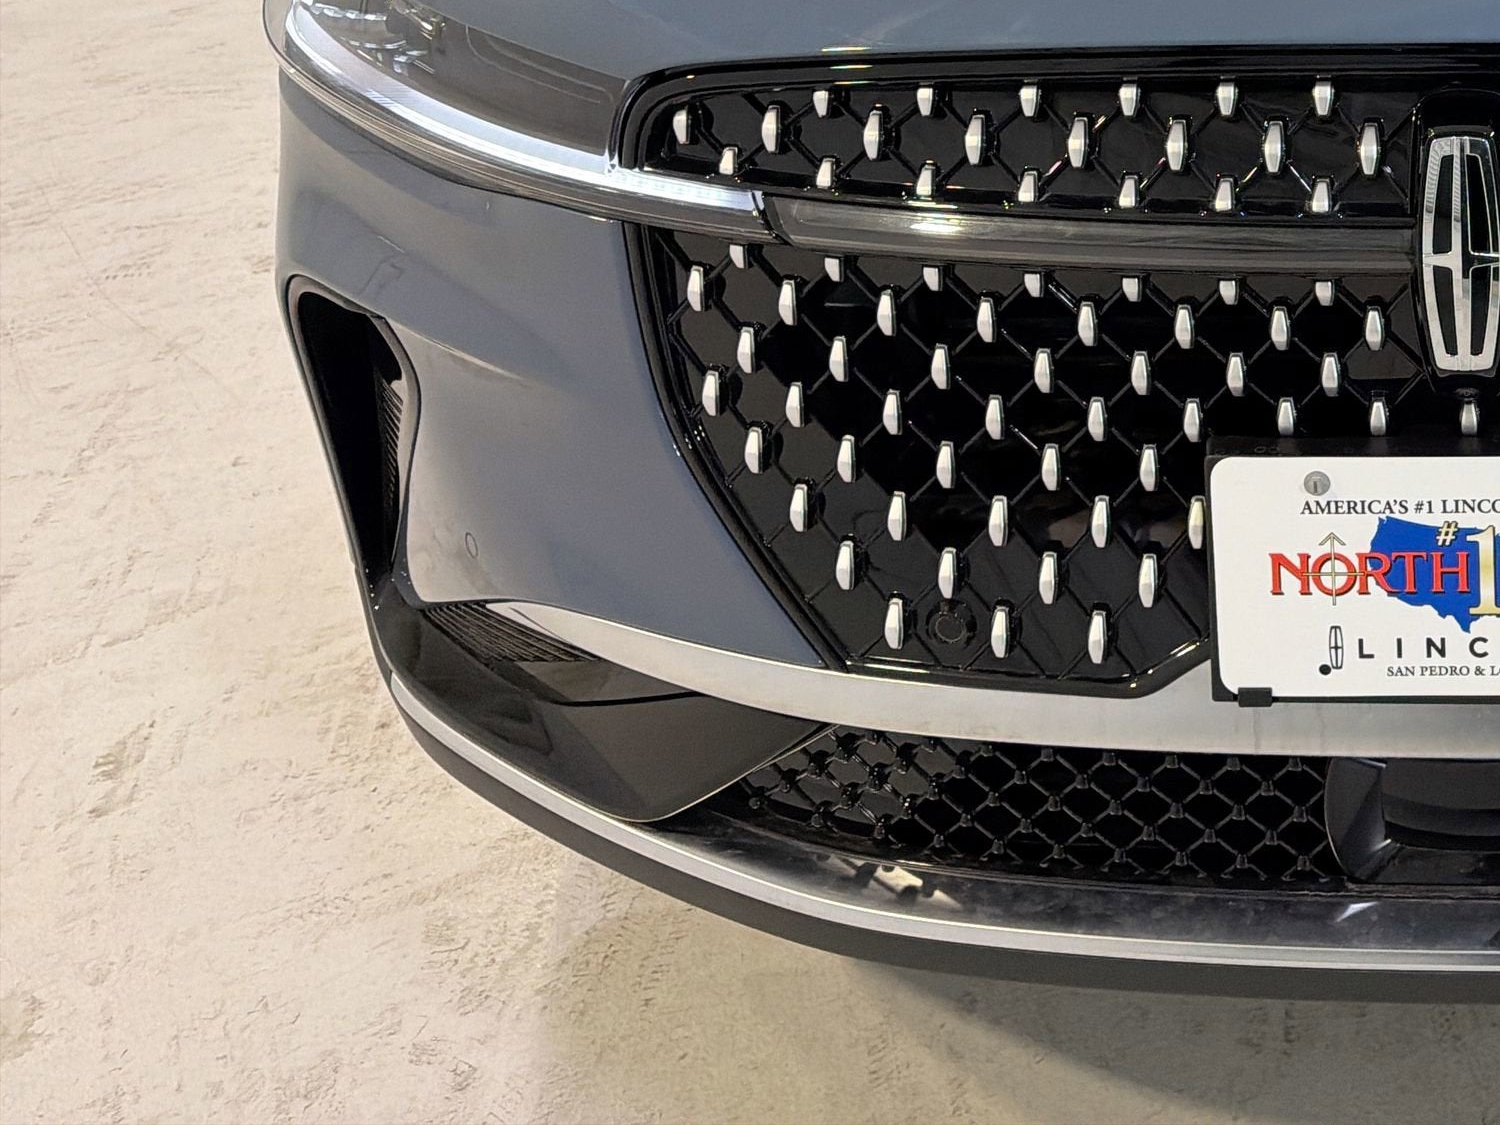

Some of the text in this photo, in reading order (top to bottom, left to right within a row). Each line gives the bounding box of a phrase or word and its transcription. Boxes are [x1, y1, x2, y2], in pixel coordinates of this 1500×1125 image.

[1300, 499, 1409, 515] AMERICA'S
[1414, 500, 1434, 514] #1
[1268, 552, 1472, 596] NORTH
[1386, 665, 1415, 677] SAN
[1420, 665, 1469, 677] PEDRO
[1474, 665, 1486, 677] &
